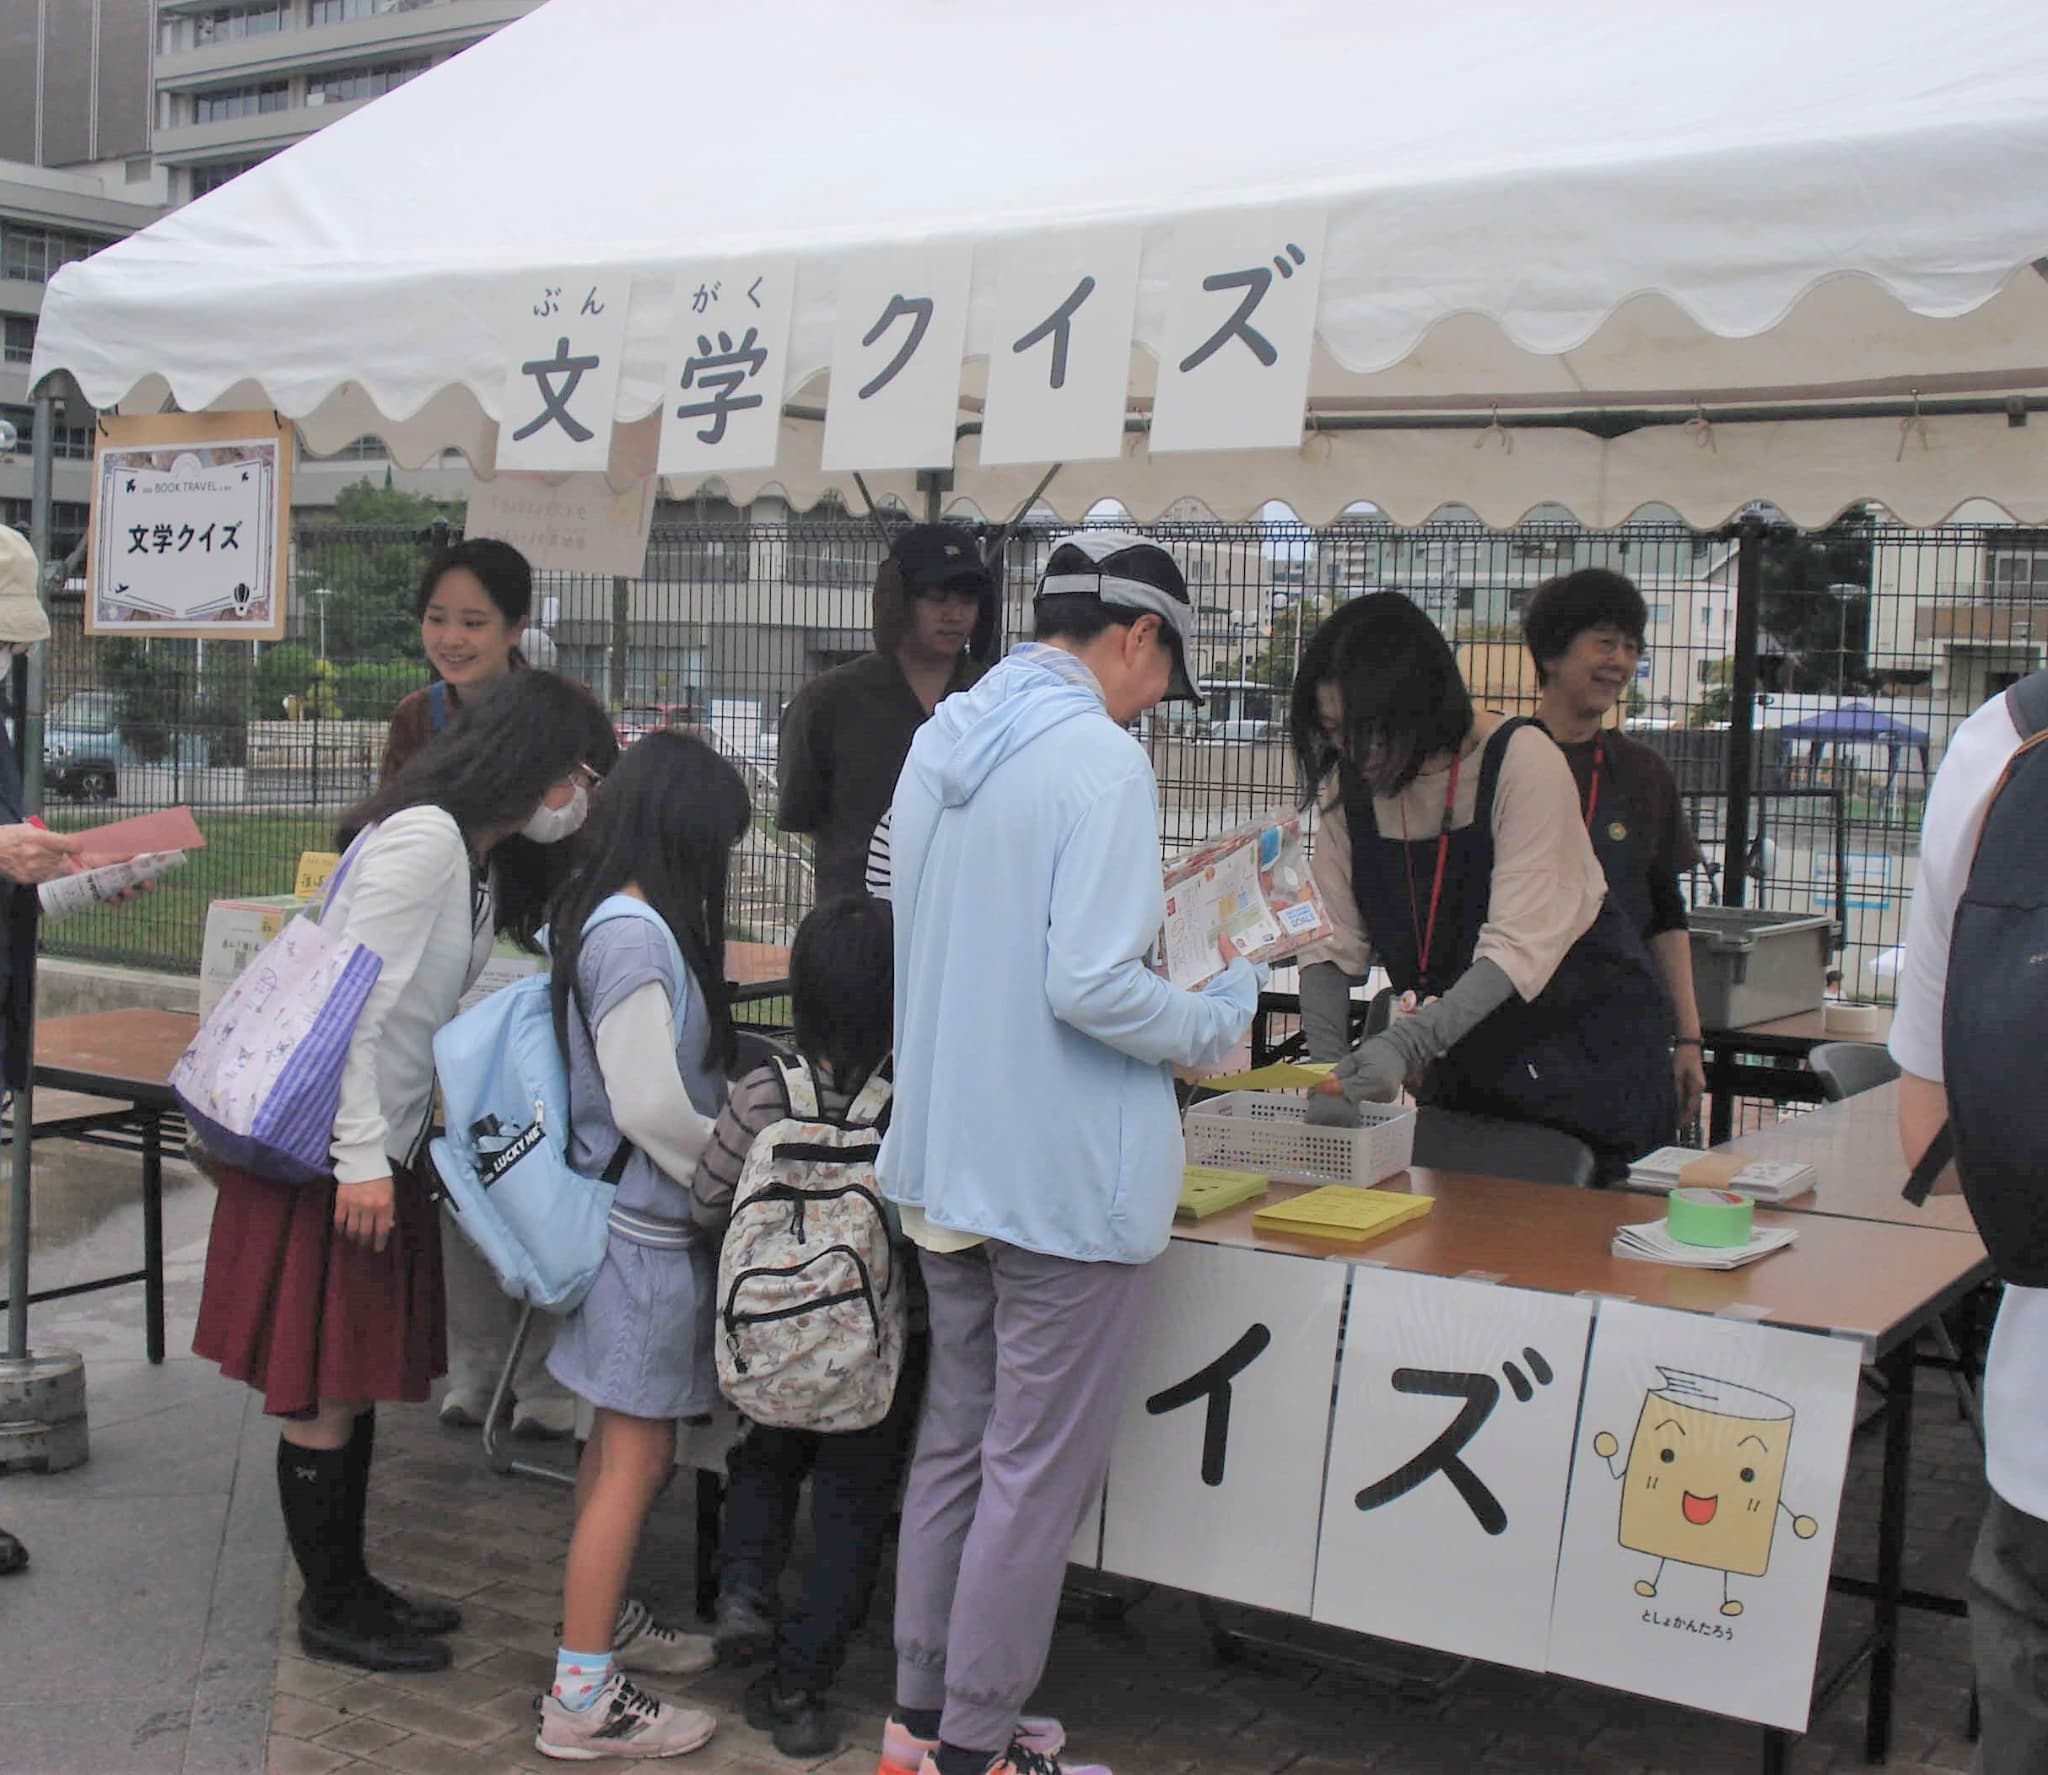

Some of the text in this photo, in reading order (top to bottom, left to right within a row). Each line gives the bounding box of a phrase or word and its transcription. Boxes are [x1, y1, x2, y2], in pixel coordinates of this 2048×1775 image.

[533, 275, 765, 318] ぶん がく
[511, 242, 1306, 444] 文学クイズ
[154, 482, 180, 494] BOOK
[183, 480, 217, 492] TRAVEL
[127, 520, 243, 554] 文学クイズ
[493, 1138, 525, 1173] LUCKY
[1641, 1608, 1734, 1641] としょかんたろう
